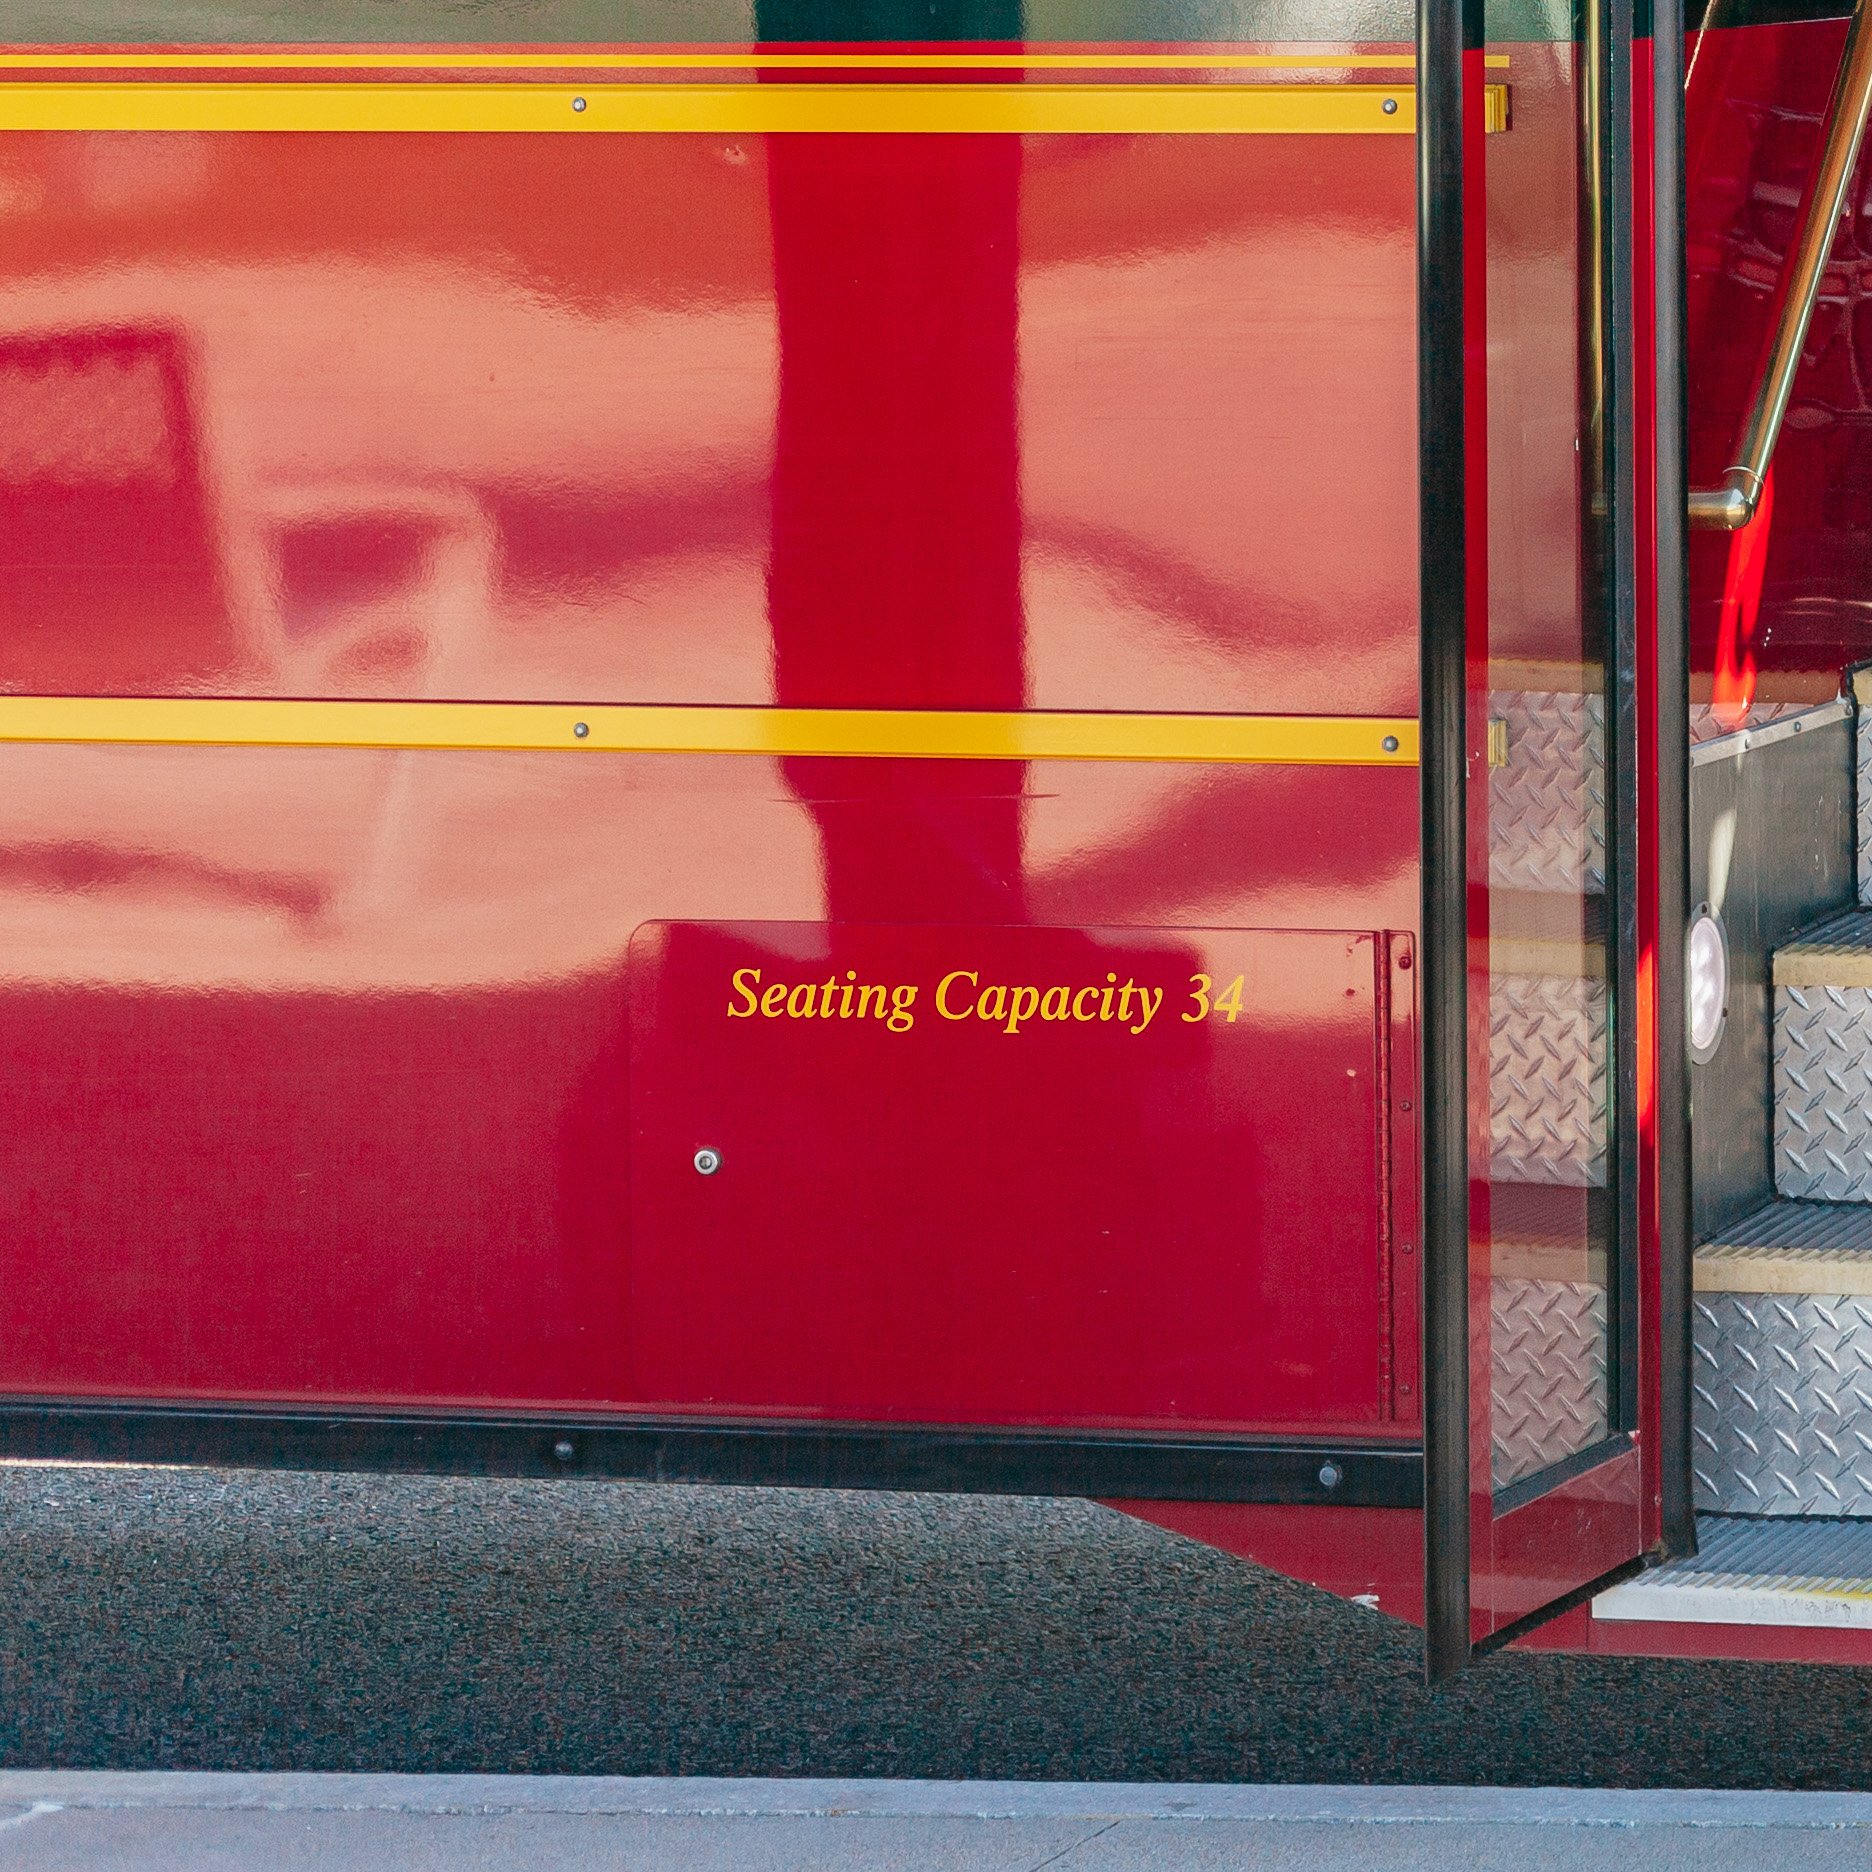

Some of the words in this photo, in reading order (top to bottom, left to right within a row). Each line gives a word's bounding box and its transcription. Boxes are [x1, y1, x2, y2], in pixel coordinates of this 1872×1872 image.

[726, 966, 918, 1033] Seating
[935, 969, 1163, 1034] Capacity
[1180, 972, 1246, 1024] 34
